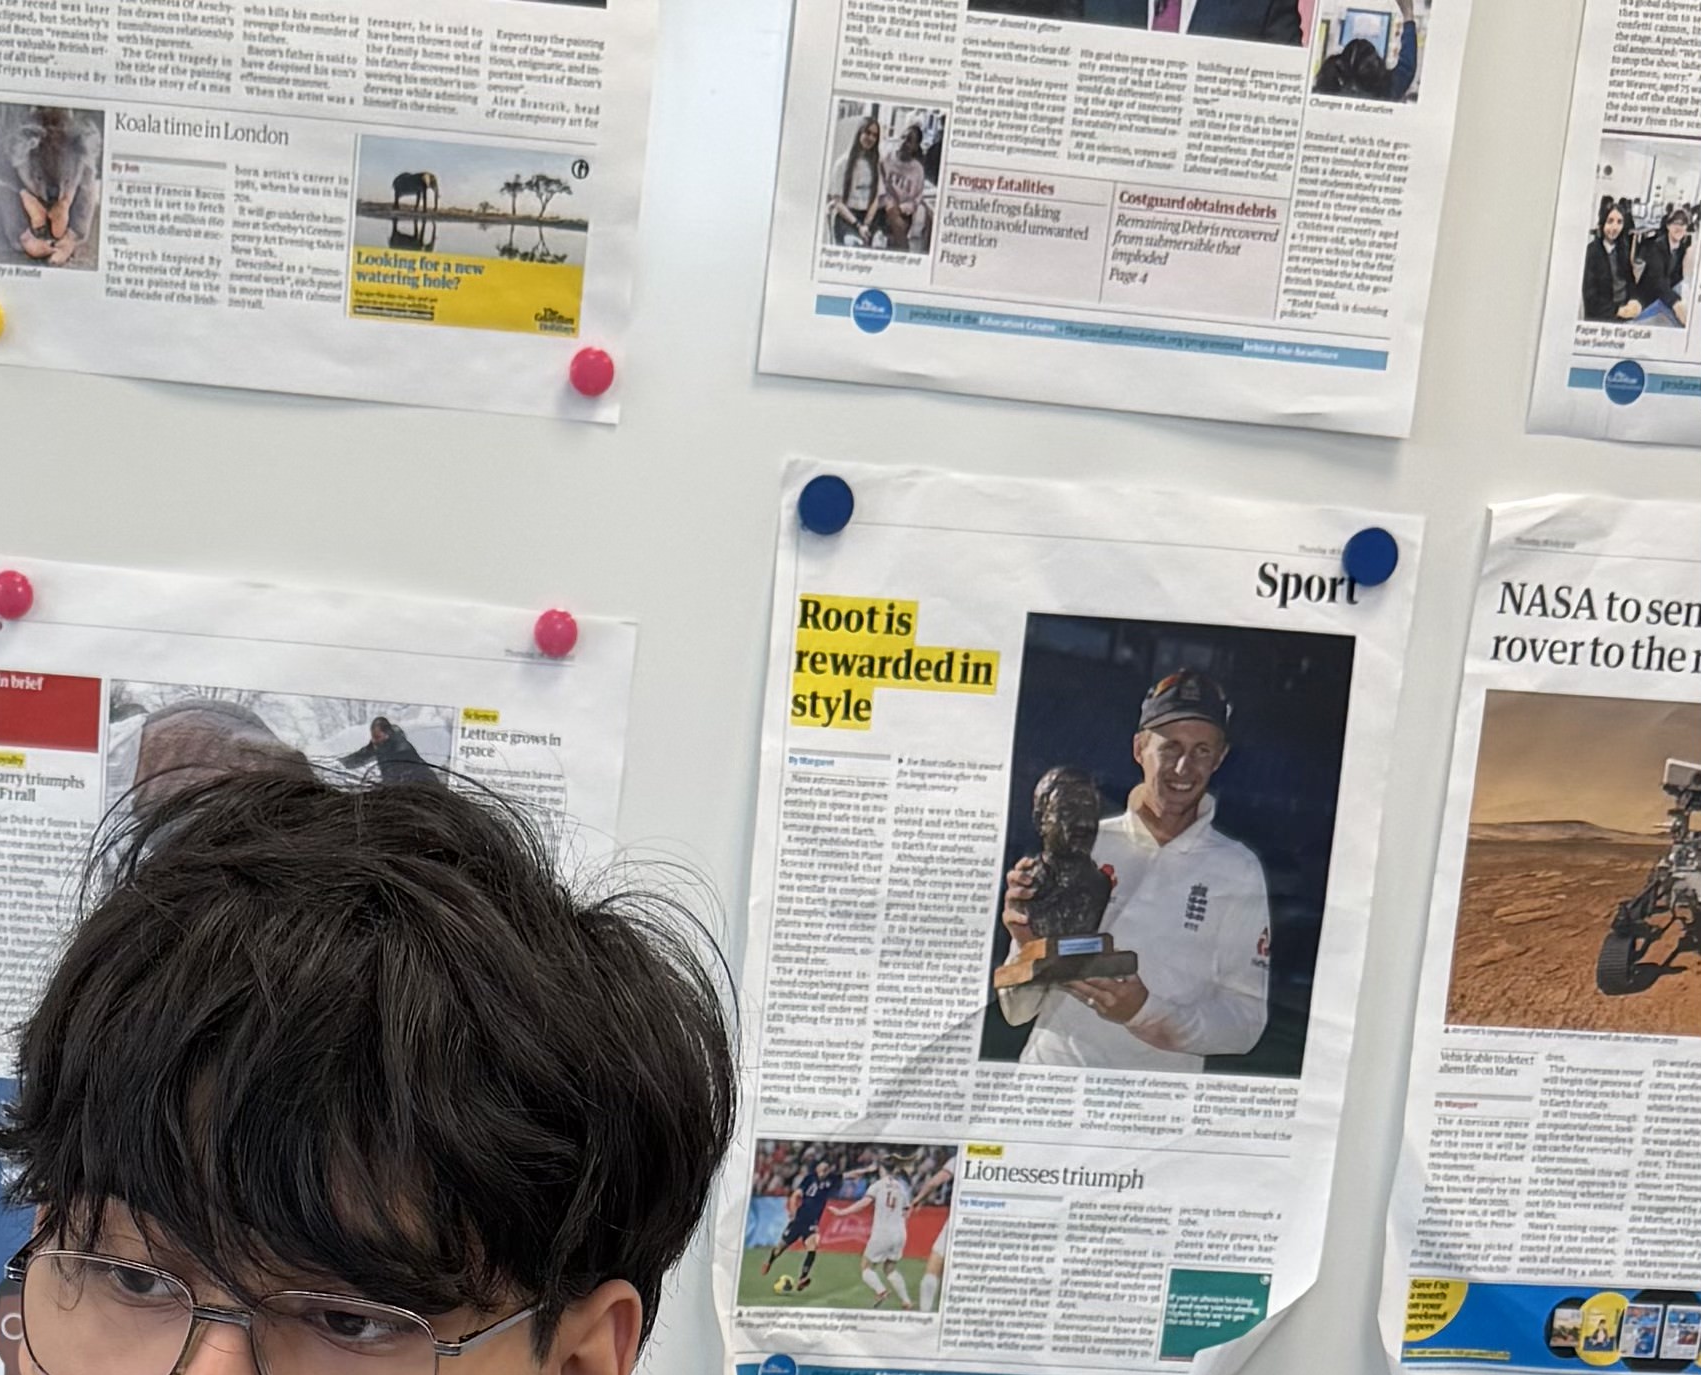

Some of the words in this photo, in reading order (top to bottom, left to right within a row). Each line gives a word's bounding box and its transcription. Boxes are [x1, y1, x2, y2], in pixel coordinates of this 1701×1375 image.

[115, 112, 161, 133] Koala
[164, 116, 203, 137] time
[205, 120, 221, 139] in
[224, 122, 289, 146] London
[949, 172, 995, 191] Froggy
[997, 177, 1055, 195] fatalities
[946, 196, 990, 213] Female
[991, 199, 1021, 218] frogs
[1023, 202, 1061, 222] faking
[1119, 191, 1184, 211] Costguard
[1185, 196, 1235, 216] obtains
[1236, 202, 1277, 219] debris
[943, 213, 979, 230] death
[980, 217, 993, 230] to
[995, 217, 1027, 234] avoid
[1028, 224, 1089, 241] unwanted
[1116, 214, 1181, 235] Remaining
[1182, 219, 1220, 236] Debris
[1221, 226, 1279, 243] recovered
[941, 233, 997, 248] attention
[1113, 230, 1144, 246] from
[1146, 234, 1215, 254] submersible
[1214, 241, 1241, 256] that
[357, 252, 416, 271] Looking
[420, 256, 440, 272] for
[445, 263, 452, 273] a
[455, 263, 485, 275] new
[940, 250, 967, 267] Page
[968, 255, 976, 268] 3
[1112, 250, 1169, 267] imploded
[356, 270, 419, 289] watering
[423, 273, 461, 291] hole?
[1109, 267, 1136, 284] Page
[1139, 272, 1148, 284] 4
[1255, 561, 1358, 609] Sport
[798, 599, 881, 635] Root
[884, 602, 911, 635] is
[1497, 581, 1597, 620] NASA
[1606, 591, 1641, 623] to
[1646, 599, 1701, 628] sen
[1490, 634, 1585, 666] rover
[1590, 636, 1624, 668] to
[1631, 635, 1686, 672] the
[795, 648, 953, 684] rewarded
[959, 652, 992, 685] in
[11, 675, 43, 691] brief
[791, 689, 872, 728] style
[460, 727, 508, 743] Lettuce
[510, 733, 547, 745] grows
[550, 733, 561, 746] in
[460, 745, 495, 758] space
[26, 772, 85, 791] triumphs
[964, 1160, 1059, 1185] Lionesses
[1062, 1166, 1144, 1193] triumph
